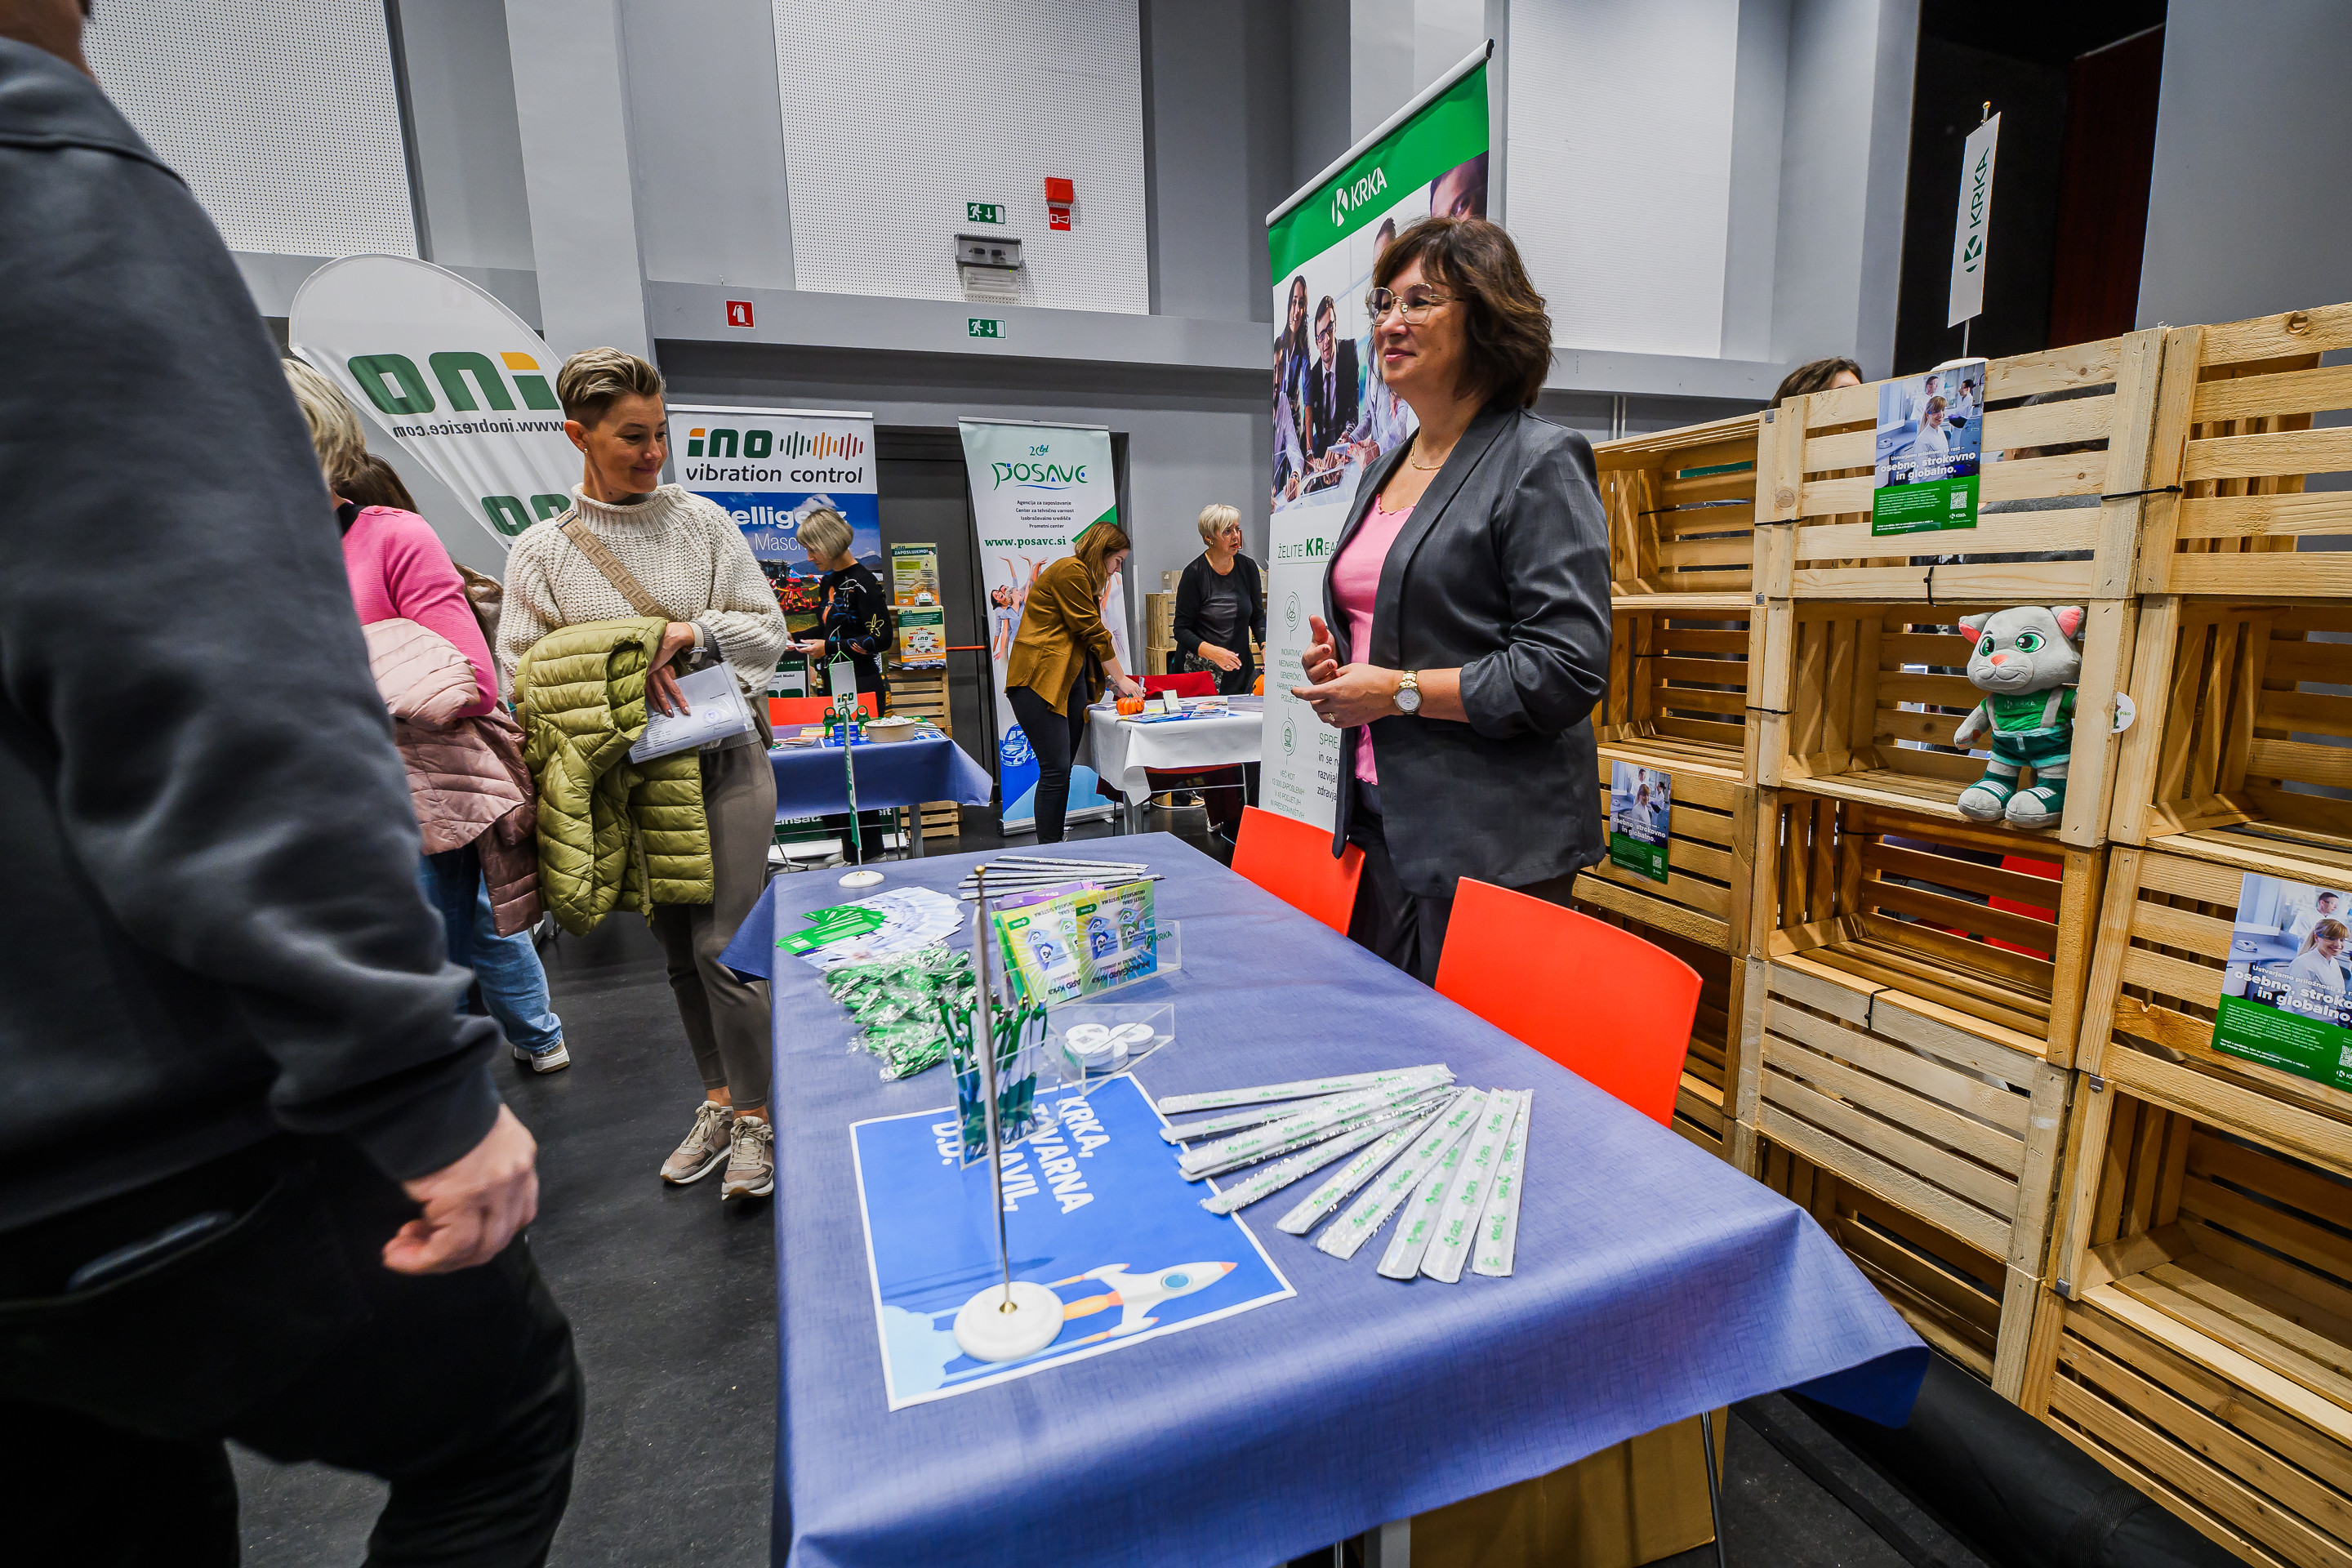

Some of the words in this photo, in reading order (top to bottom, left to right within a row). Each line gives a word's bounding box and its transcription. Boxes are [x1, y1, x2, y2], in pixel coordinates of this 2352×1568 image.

[1350, 166, 1388, 212] KRKA
[1969, 146, 1989, 229] KRKA
[687, 428, 773, 459] ino
[1880, 460, 1919, 473] osebno,
[1922, 452, 1976, 467] strokovno
[1891, 452, 1918, 461] Ustvarjamo
[686, 463, 782, 483] vibration
[790, 466, 863, 483] control
[991, 462, 1089, 491] POSAVC
[1895, 470, 1906, 481] in
[1908, 466, 1958, 481] globalno.
[984, 536, 1067, 549] www.posavc.si
[1277, 542, 1303, 559] ŽELITE
[1318, 751, 1324, 763] in
[1325, 755, 1333, 765] se
[1622, 825, 1628, 833] in
[1636, 824, 1666, 838] strokovno
[1102, 896, 1120, 906] SISTEMA
[1155, 930, 1173, 942] KRKA
[2234, 970, 2296, 996] osebno,
[2252, 964, 2294, 981] Ustvarjamo
[2295, 976, 2336, 991] priložnosti
[2256, 986, 2273, 1000] in
[1056, 1095, 1111, 1158] KRKA,
[1000, 1143, 1040, 1212] AVIL,
